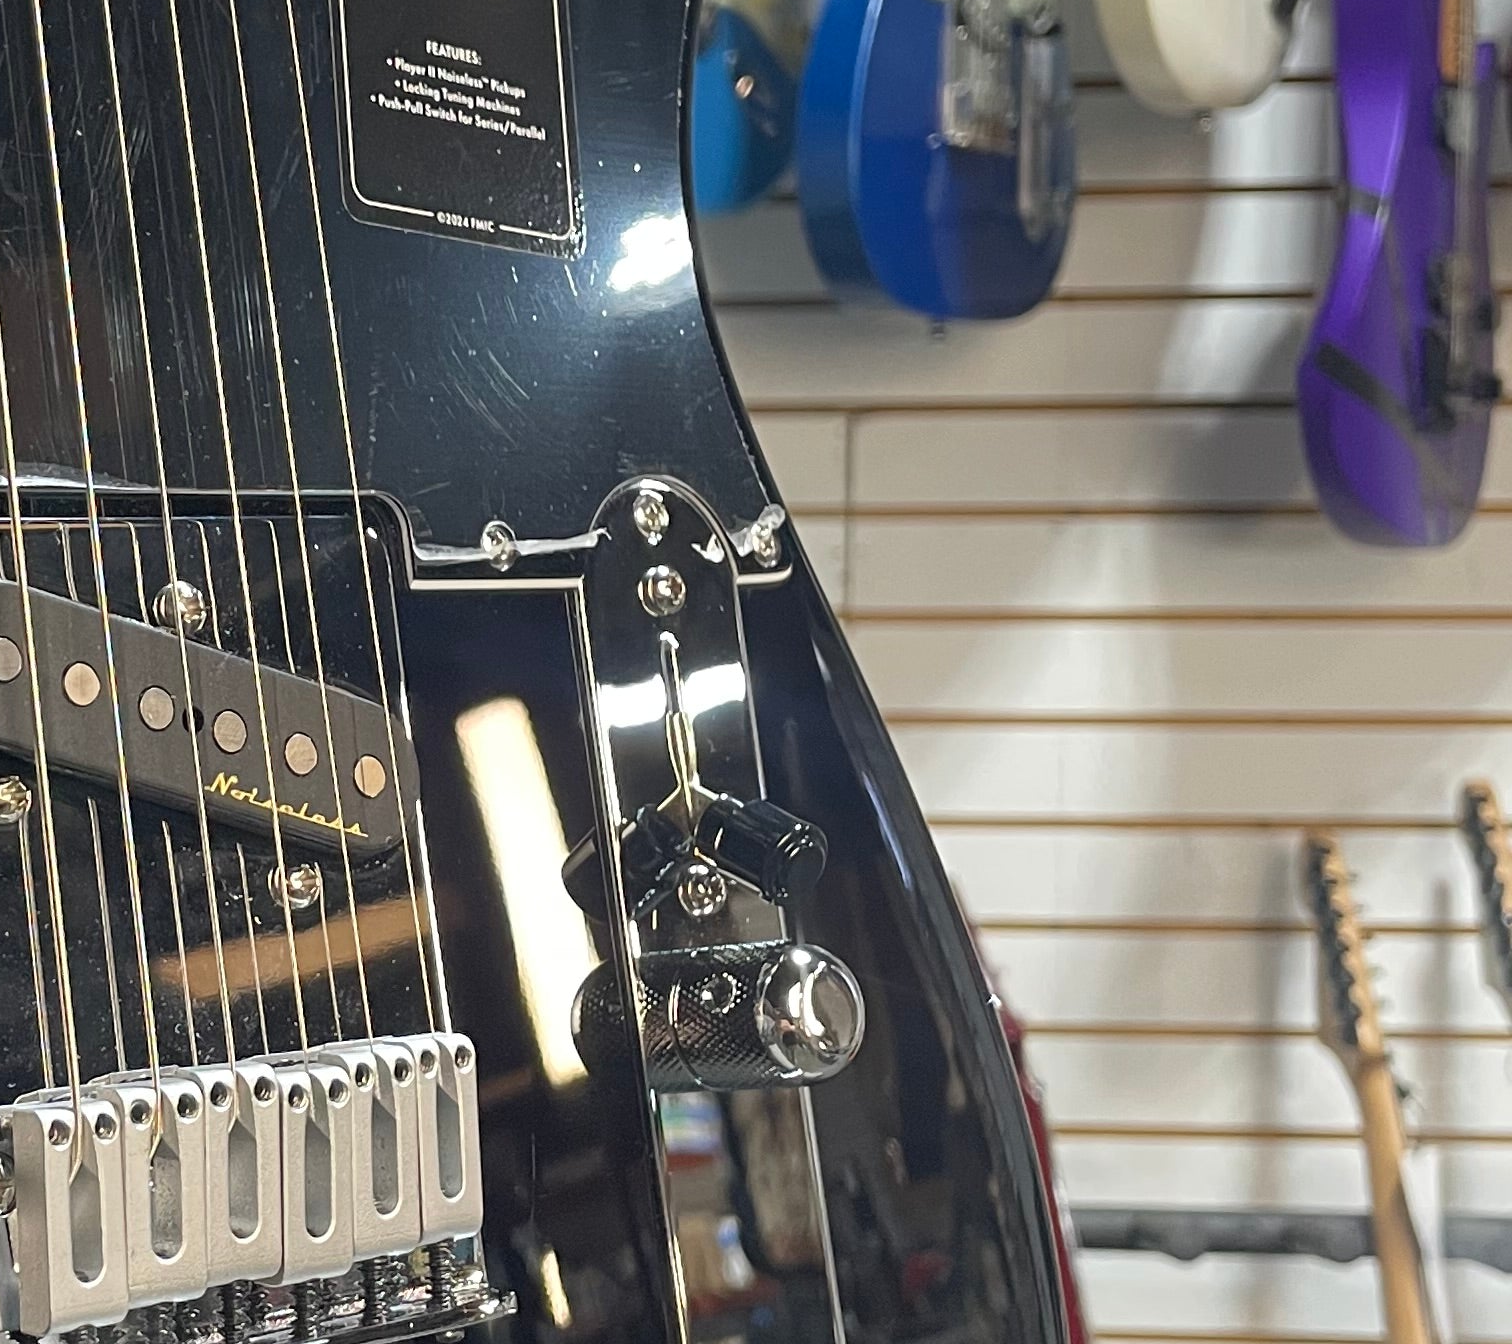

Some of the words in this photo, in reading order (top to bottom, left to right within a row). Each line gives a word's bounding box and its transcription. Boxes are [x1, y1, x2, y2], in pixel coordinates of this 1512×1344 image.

[425, 39, 482, 66] FEATURES:
[394, 57, 426, 76] Player
[427, 66, 436, 78] II
[490, 79, 526, 98] Pickups
[402, 79, 441, 102] Locking
[442, 88, 475, 109] Tuning
[476, 95, 521, 117] Machines
[378, 93, 424, 115] Push-Pull
[424, 104, 457, 122] Switch
[458, 111, 473, 125] for
[474, 114, 546, 141] Series/Parallel
[203, 771, 369, 838] Noiseless
